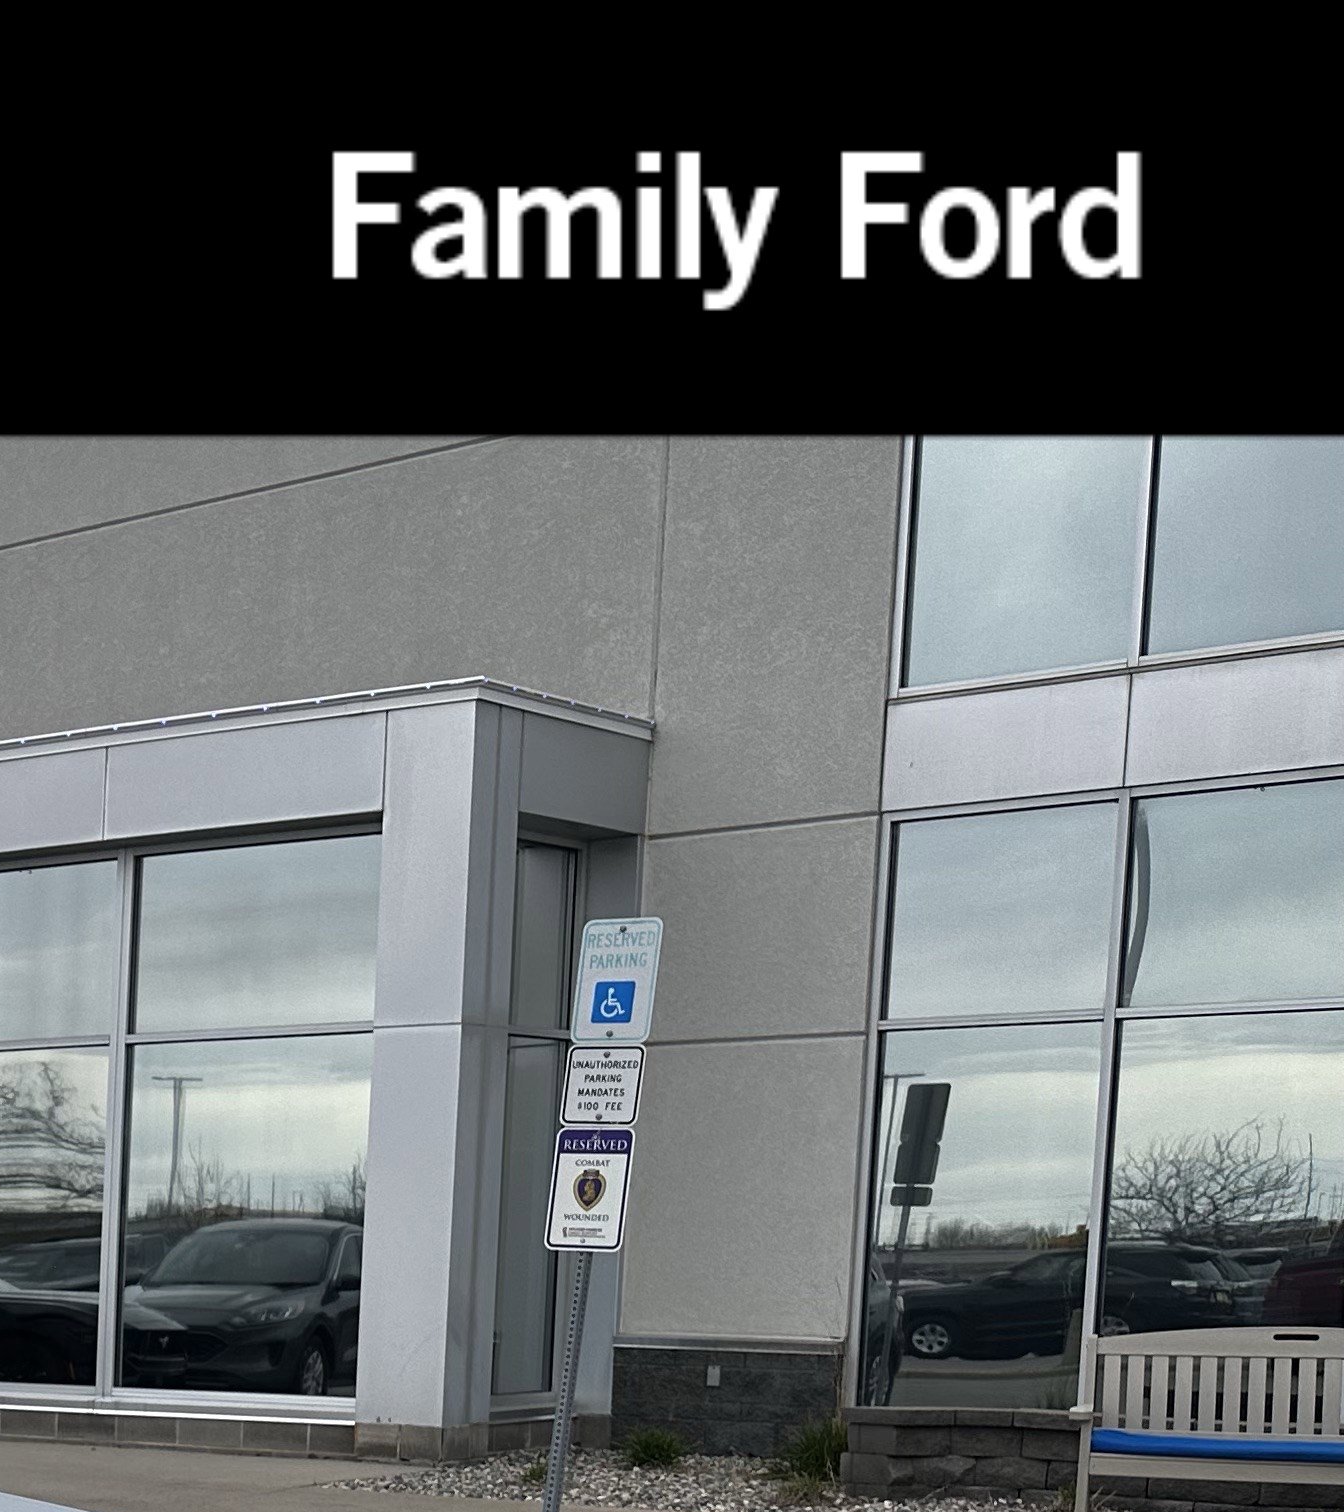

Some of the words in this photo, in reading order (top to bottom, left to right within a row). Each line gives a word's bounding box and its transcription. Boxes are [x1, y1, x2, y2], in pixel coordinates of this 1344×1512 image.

[587, 930, 656, 949] RESERVED
[589, 952, 648, 970] PARKING
[572, 1060, 639, 1069] UNAUTHORIZED
[584, 1073, 623, 1083] PARKING
[577, 1087, 626, 1097] MANDATES
[604, 1101, 623, 1111] FEE
[563, 1138, 628, 1151] RESERVED
[575, 1159, 611, 1167] COMBAT
[563, 1213, 610, 1222] WOUNDED
